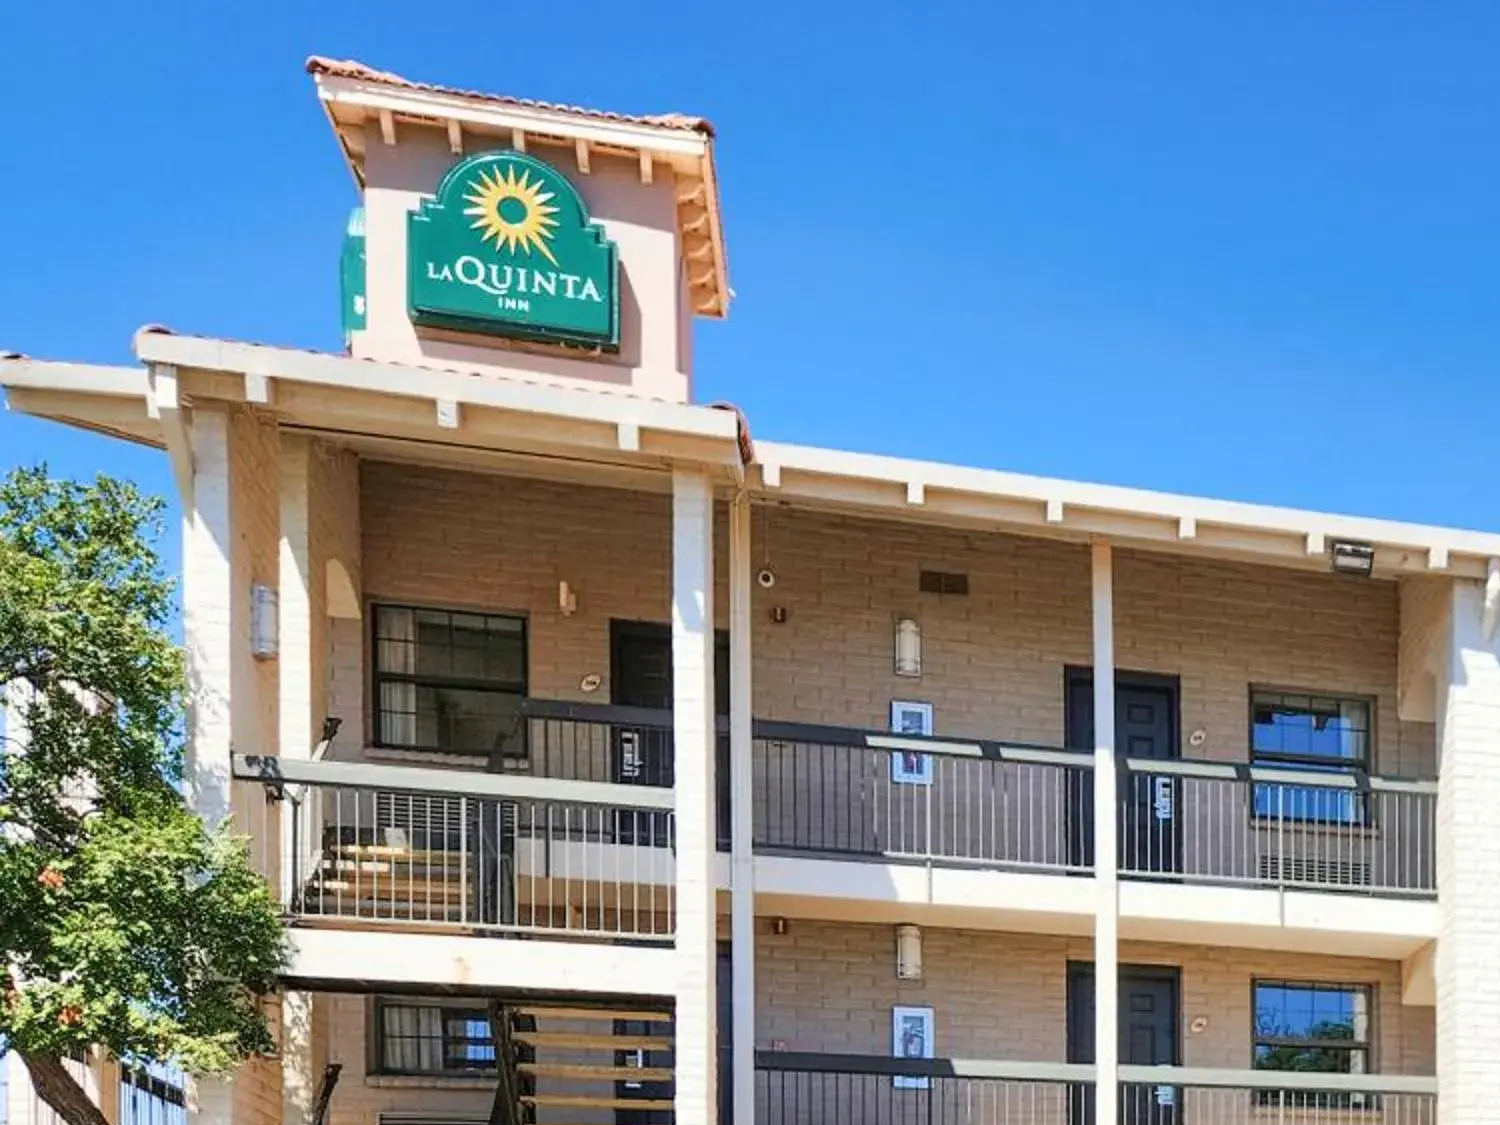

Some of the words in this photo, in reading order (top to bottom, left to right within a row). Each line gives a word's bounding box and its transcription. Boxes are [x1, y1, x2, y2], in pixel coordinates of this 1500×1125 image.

[427, 262, 453, 282] LA
[455, 255, 602, 302] QUINTA
[498, 297, 530, 313] INN
